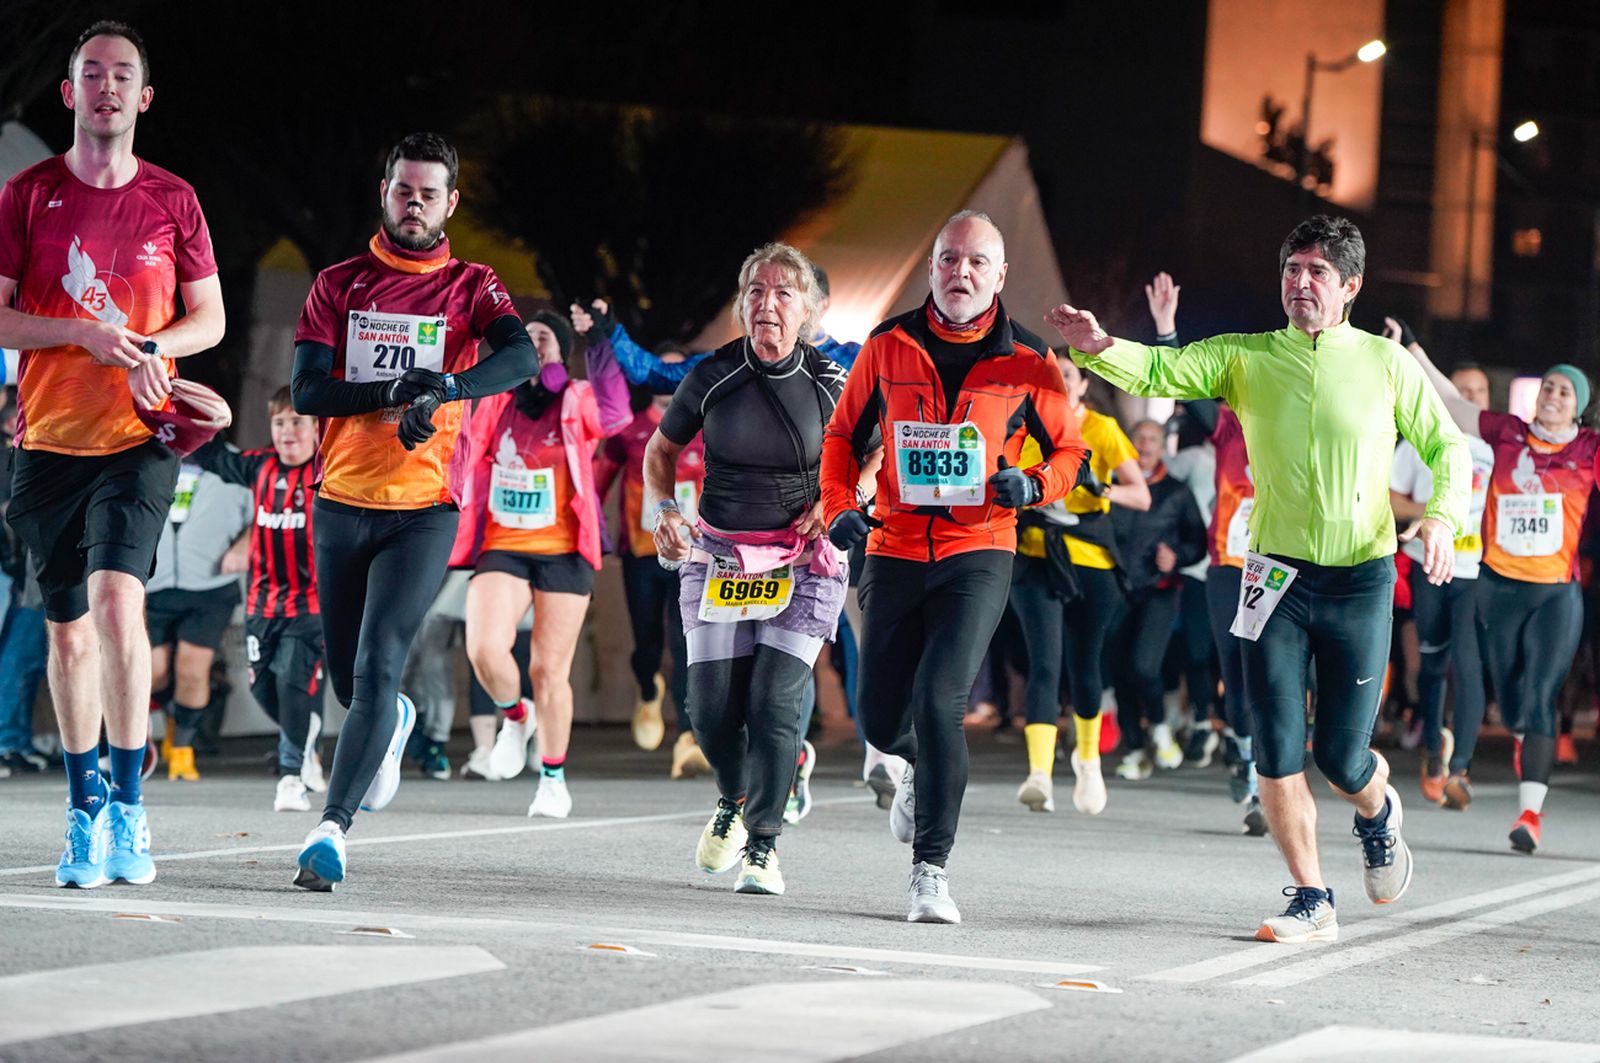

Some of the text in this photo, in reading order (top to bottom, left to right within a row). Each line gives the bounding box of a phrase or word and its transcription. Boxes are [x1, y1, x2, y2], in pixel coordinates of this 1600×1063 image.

[81, 286, 106, 311] 43
[369, 322, 410, 332] NOCHE DE
[358, 332, 377, 340] SAN
[373, 344, 416, 370] 270
[912, 430, 939, 438] NOCHE
[902, 439, 918, 448] SAN
[908, 450, 968, 476] 8333
[257, 505, 306, 529] bwin
[1510, 517, 1548, 534] 7349
[717, 571, 734, 579] SAN
[1254, 564, 1264, 574] DE
[720, 580, 779, 600] 6969
